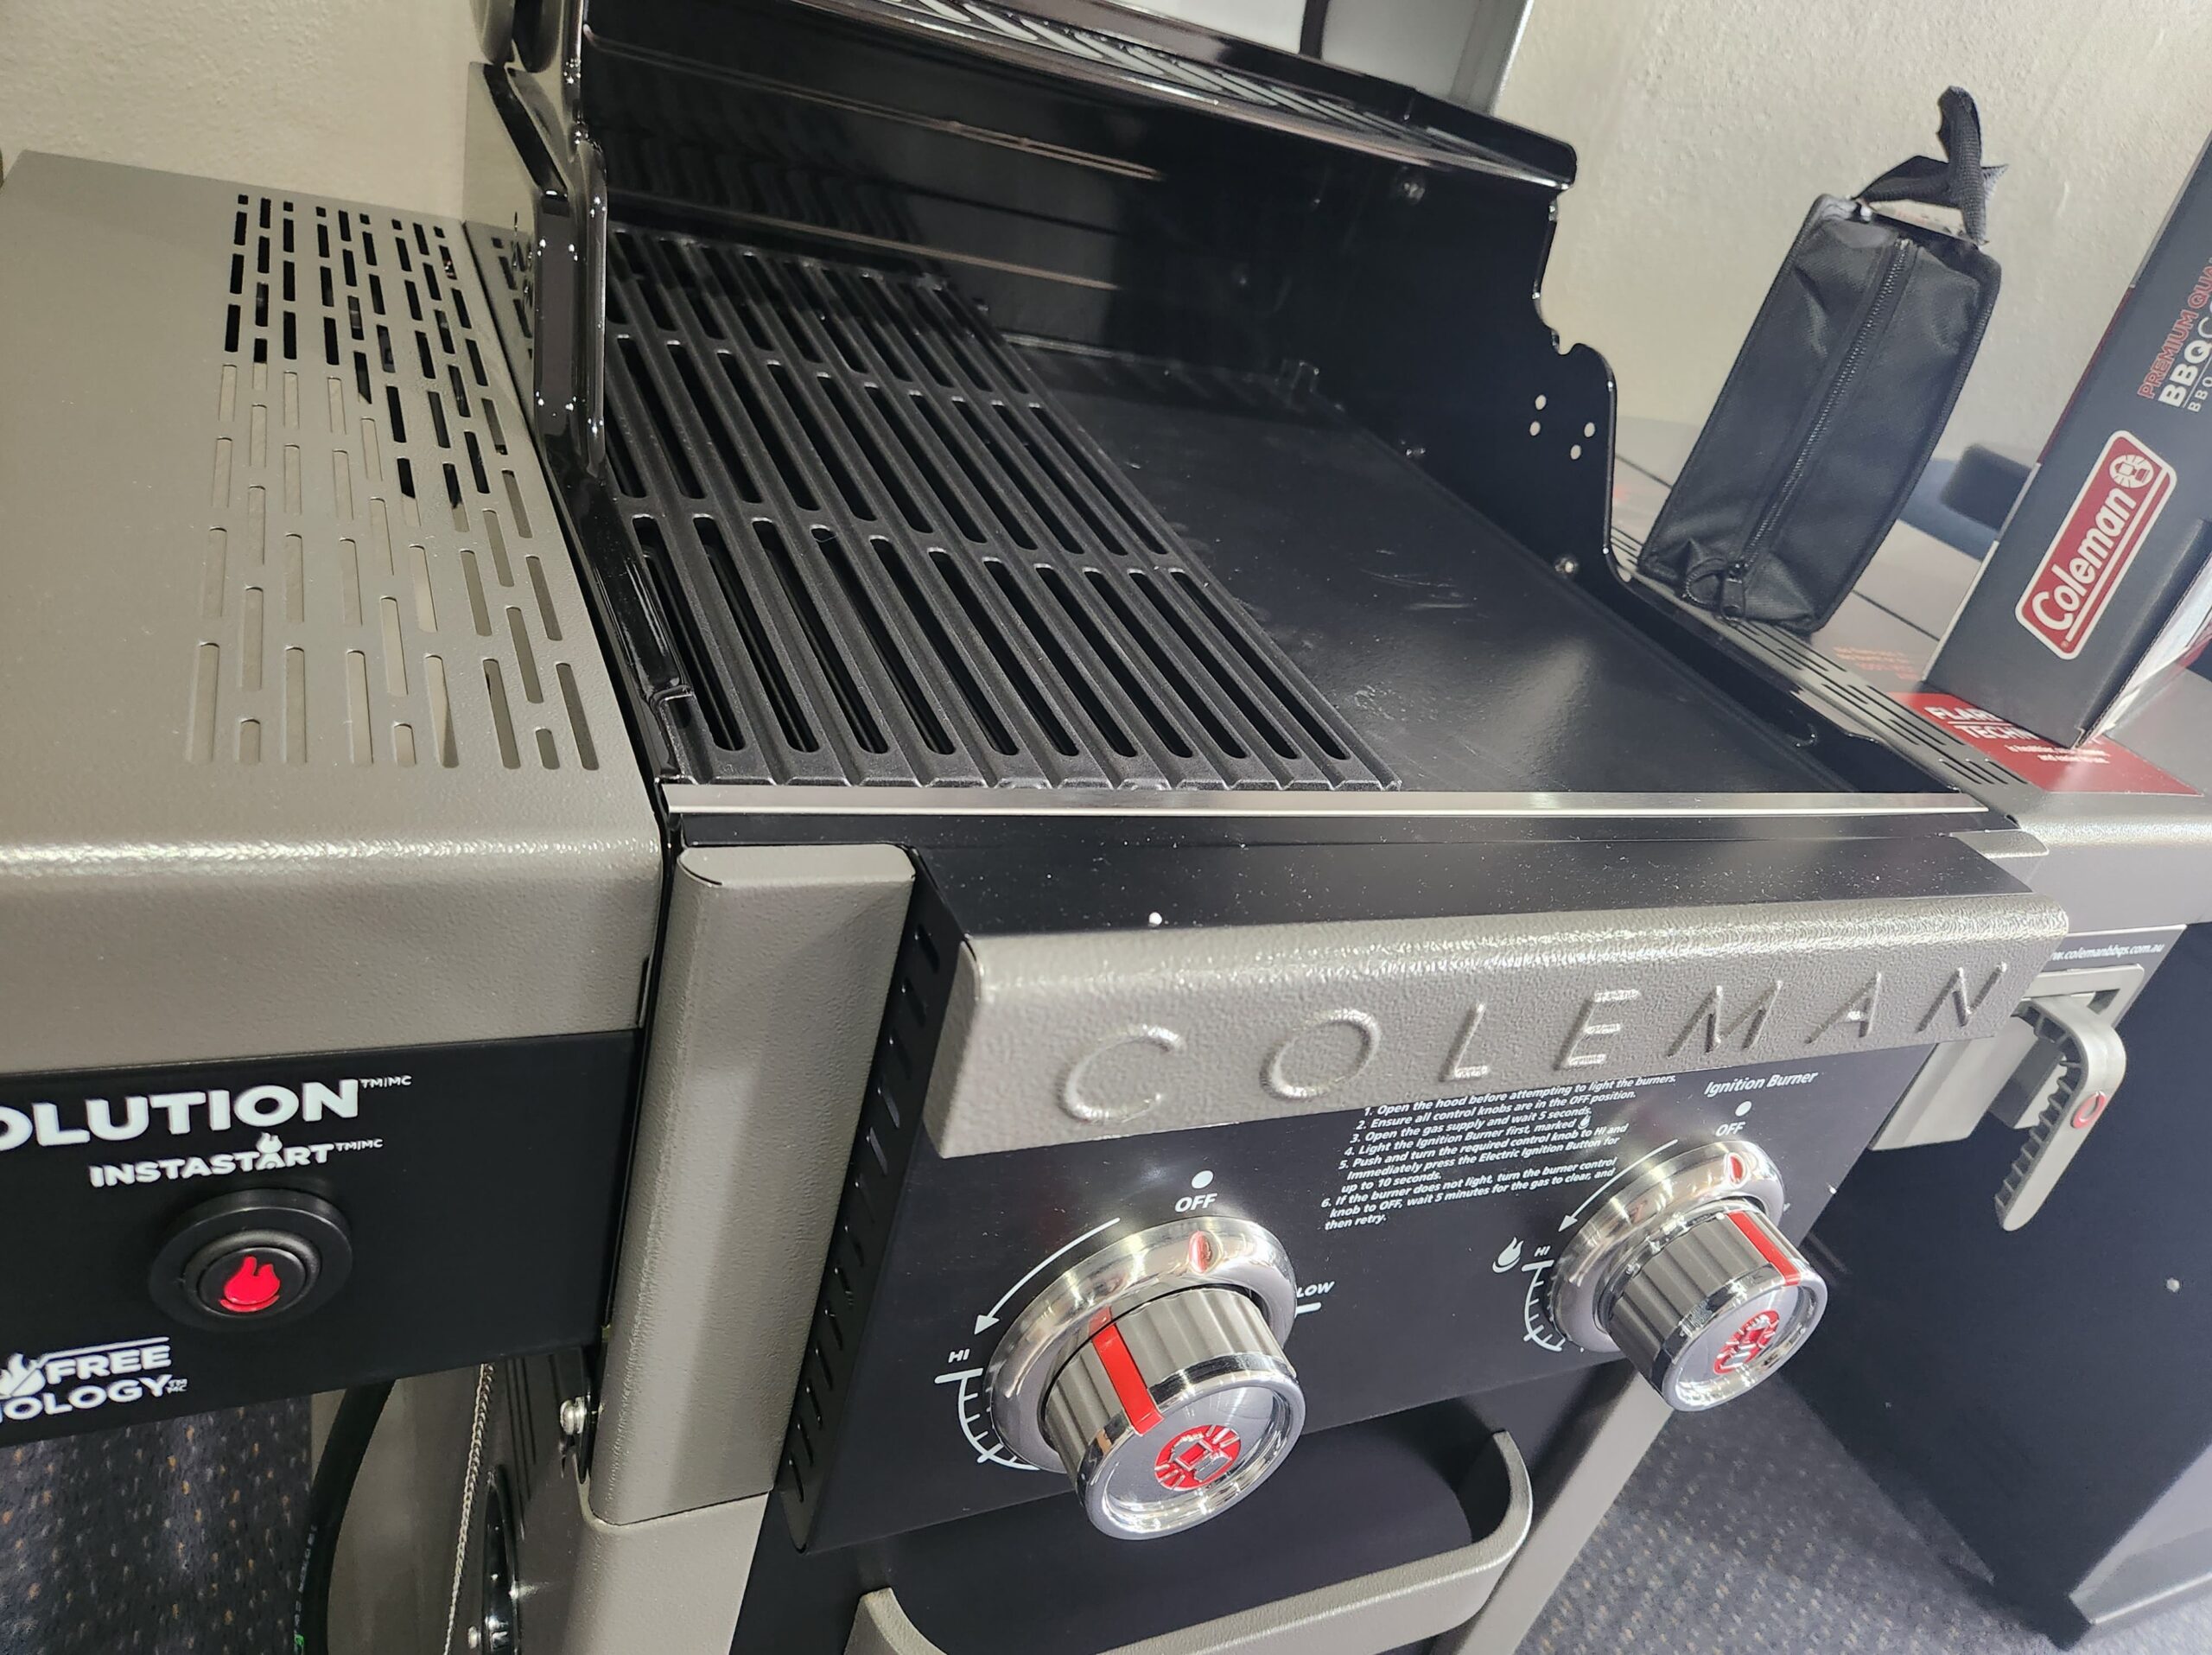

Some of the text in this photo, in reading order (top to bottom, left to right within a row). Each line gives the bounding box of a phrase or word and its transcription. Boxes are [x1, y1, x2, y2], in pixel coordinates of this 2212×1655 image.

[2137, 309, 2199, 399] PREMIUM
[2031, 487, 2137, 630] Coleman
[1056, 962, 2007, 1123] COLEMAN
[1377, 1103, 1409, 1117] Open
[1413, 1101, 1433, 1111] the
[1435, 1097, 1467, 1109] hood
[1469, 1092, 1507, 1105] before
[1510, 1085, 1573, 1101] attempting
[1574, 1083, 1586, 1092] to
[1589, 1079, 1615, 1092] light
[1616, 1078, 1634, 1088] the
[1635, 1074, 1676, 1086] burners.
[1704, 1073, 1819, 1098] Ignition Burner
[1350, 1134, 1360, 1143] 3.
[1365, 1130, 1397, 1143] Open
[1401, 1127, 1421, 1137] the
[1422, 1124, 1443, 1136] gas
[1446, 1119, 1484, 1133] supply
[1487, 1115, 1510, 1127] and
[1511, 1112, 1536, 1124] wait
[1539, 1111, 1547, 1121] 5
[1356, 1090, 1637, 1130] 2. Ensure all control knobs are in the OFF position.
[1715, 1122, 1745, 1136] OFF
[1338, 1123, 1629, 1169] 5. Push and turn the required control knob to HI and
[1344, 1147, 1355, 1156] 4.
[1358, 1143, 1391, 1155] Light
[1394, 1139, 1414, 1149] the
[1416, 1133, 1462, 1149] Ignition
[1465, 1130, 1503, 1142] Burner
[1534, 1118, 1577, 1132] marked
[89, 1143, 334, 1188] INSTASTART
[1346, 1136, 1621, 1181] Immediately press the Electric Ignition Button for
[1321, 1198, 1332, 1208] 6.
[1335, 1194, 1347, 1206] If
[1348, 1193, 1369, 1203] the
[1370, 1188, 1412, 1201] burner
[1413, 1182, 1440, 1194] does
[1442, 1179, 1462, 1190] not
[1497, 1169, 1521, 1182] turn
[1522, 1167, 1541, 1178] the
[1541, 1163, 1578, 1176] burner
[1580, 1156, 1618, 1170] control
[1329, 1168, 1617, 1219] knob to OFF, wait 5 minutes for the gas to clear, and
[1341, 1171, 1442, 1194] up to 10 seconds.
[1175, 1193, 1218, 1213] OFF
[1324, 1213, 1387, 1231] then retry.
[1534, 1245, 1551, 1257] HI
[1296, 1281, 1335, 1298] LOW
[46, 1345, 172, 1384] FREE
[948, 1348, 970, 1364] HI
[0, 1374, 172, 1423] OLOGY
